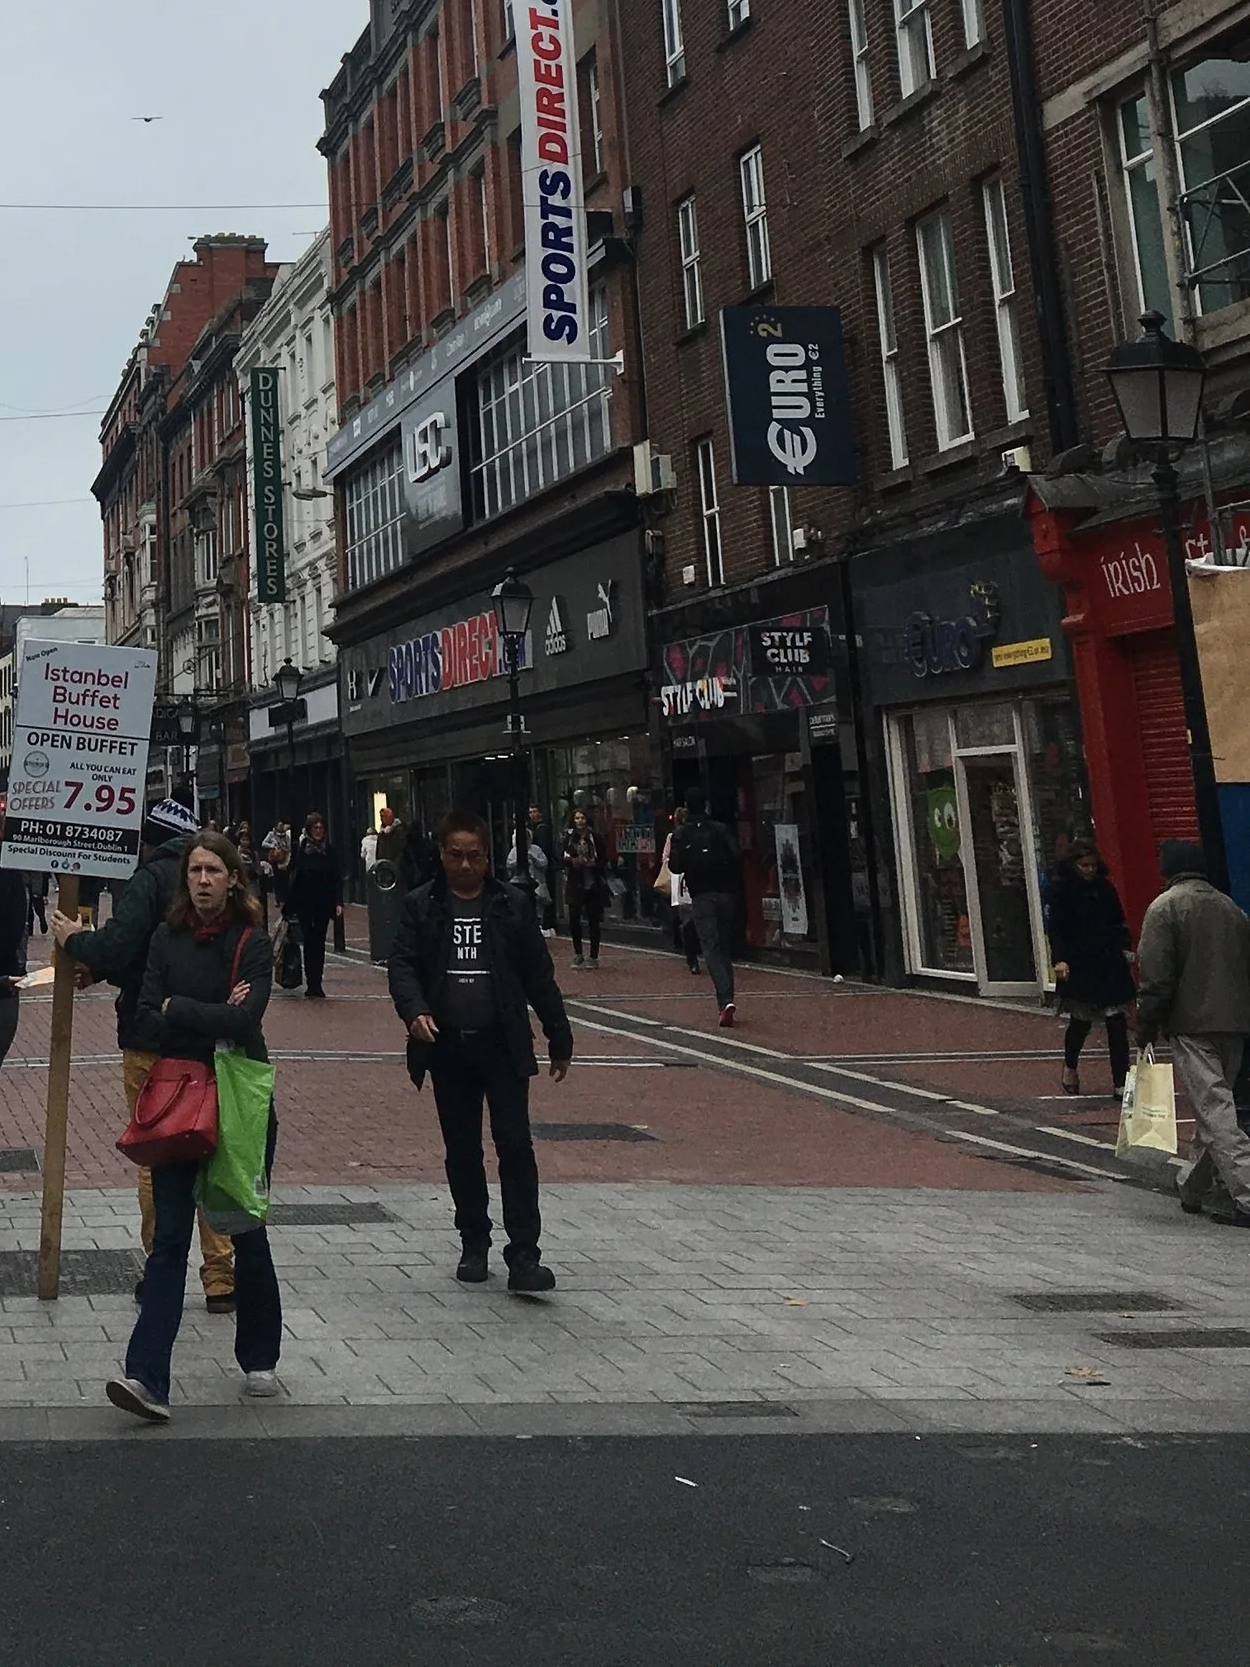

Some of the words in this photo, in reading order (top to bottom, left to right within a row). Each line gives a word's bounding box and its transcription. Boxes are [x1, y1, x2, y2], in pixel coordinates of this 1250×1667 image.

[808, 343, 821, 361] €2
[811, 366, 826, 419] Everything
[257, 372, 274, 478] DUNNES
[263, 485, 279, 596] STORES
[41, 647, 58, 658] Open
[544, 634, 567, 656] adidas
[44, 662, 129, 689] Istanbel
[52, 685, 121, 710] Buffet
[53, 707, 119, 731] House
[27, 732, 72, 750] OPEN
[76, 736, 138, 756] BUFFET
[70, 762, 85, 770] ALL
[86, 763, 104, 773] YOU
[103, 765, 122, 774] CAN
[122, 767, 137, 776] EAT
[91, 774, 113, 783] ONLY
[12, 780, 62, 795] SPECIAL
[63, 780, 137, 815] 7.95
[10, 797, 56, 811] OFFERS
[20, 820, 44, 833] PH:
[46, 824, 61, 836] 01
[65, 825, 123, 842] 8734087
[23, 834, 71, 847] Marlborough
[7, 844, 38, 855] Special
[39, 847, 76, 859] Discount
[77, 851, 92, 860] For
[93, 854, 131, 864] Students
[453, 924, 482, 946] STE
[457, 947, 477, 961] NTH
